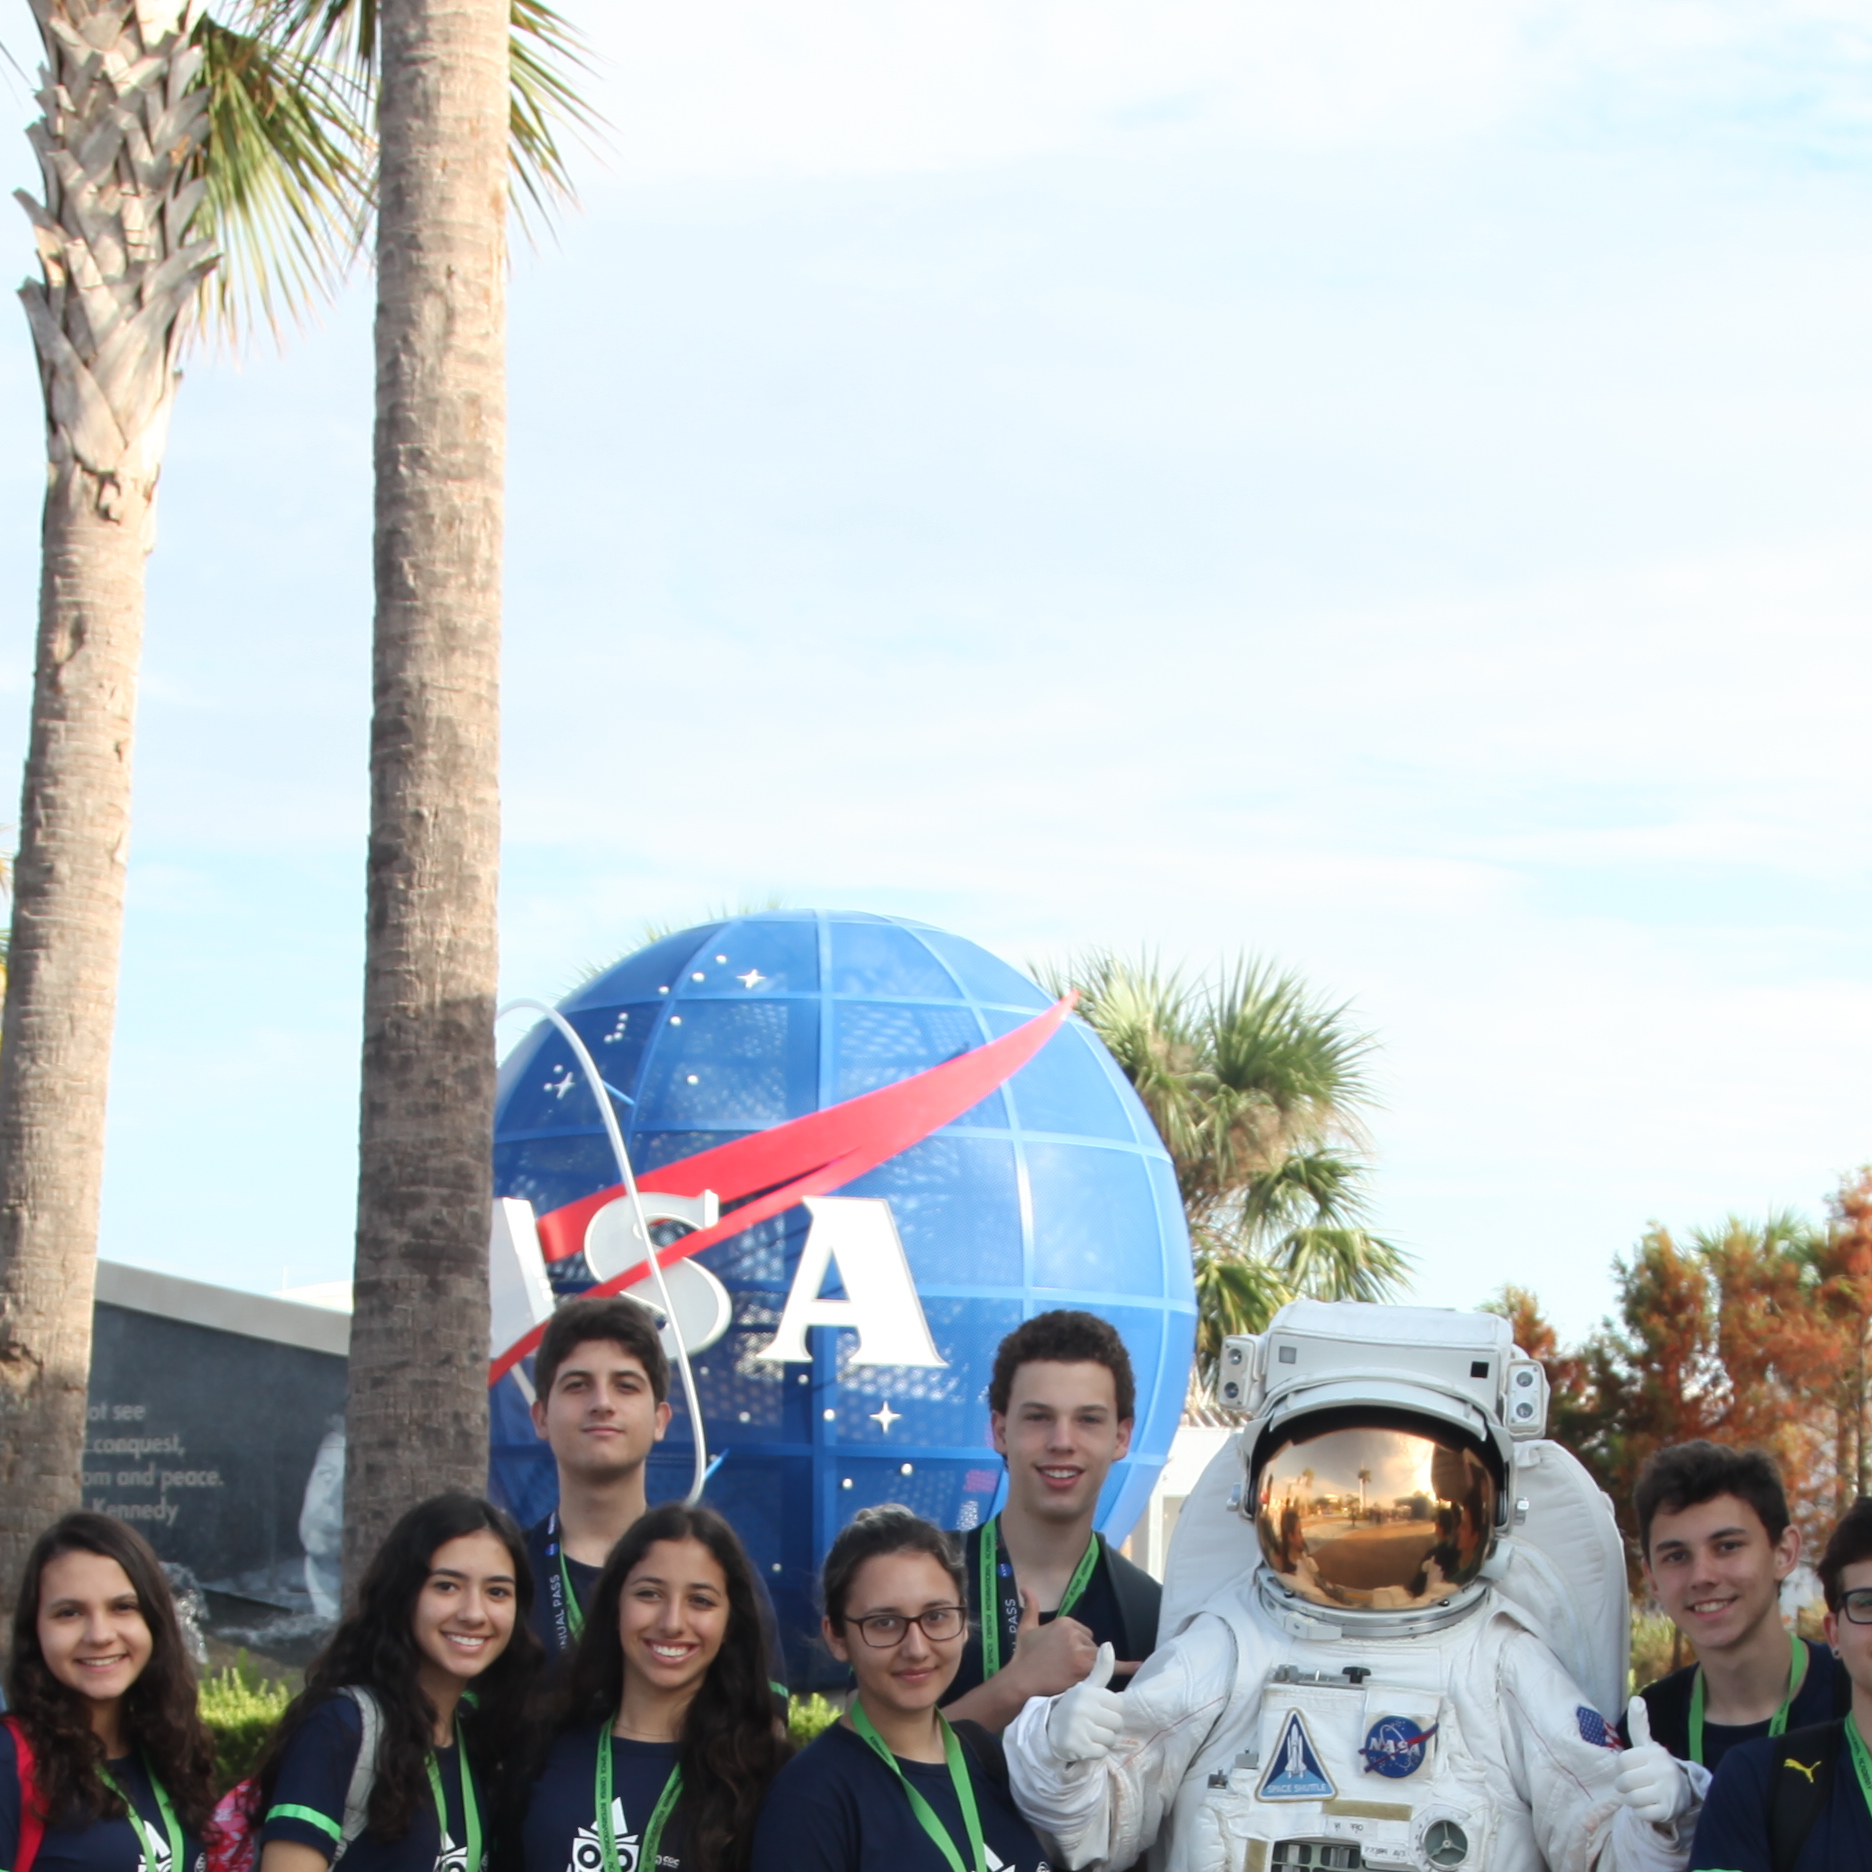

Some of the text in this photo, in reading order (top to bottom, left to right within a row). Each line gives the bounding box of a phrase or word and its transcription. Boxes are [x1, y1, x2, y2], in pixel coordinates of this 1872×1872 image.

[87, 1402, 108, 1421] ot
[112, 1405, 146, 1421] see
[93, 1433, 186, 1460] conquest,
[116, 1462, 156, 1486] and
[160, 1470, 225, 1493] peace.
[92, 1497, 179, 1527] Kennedy
[549, 1575, 562, 1607] PASS
[1004, 1598, 1021, 1634] PASS
[1369, 1736, 1422, 1759] NASA
[1268, 1782, 1327, 1794] SPACE SHUTTLE
